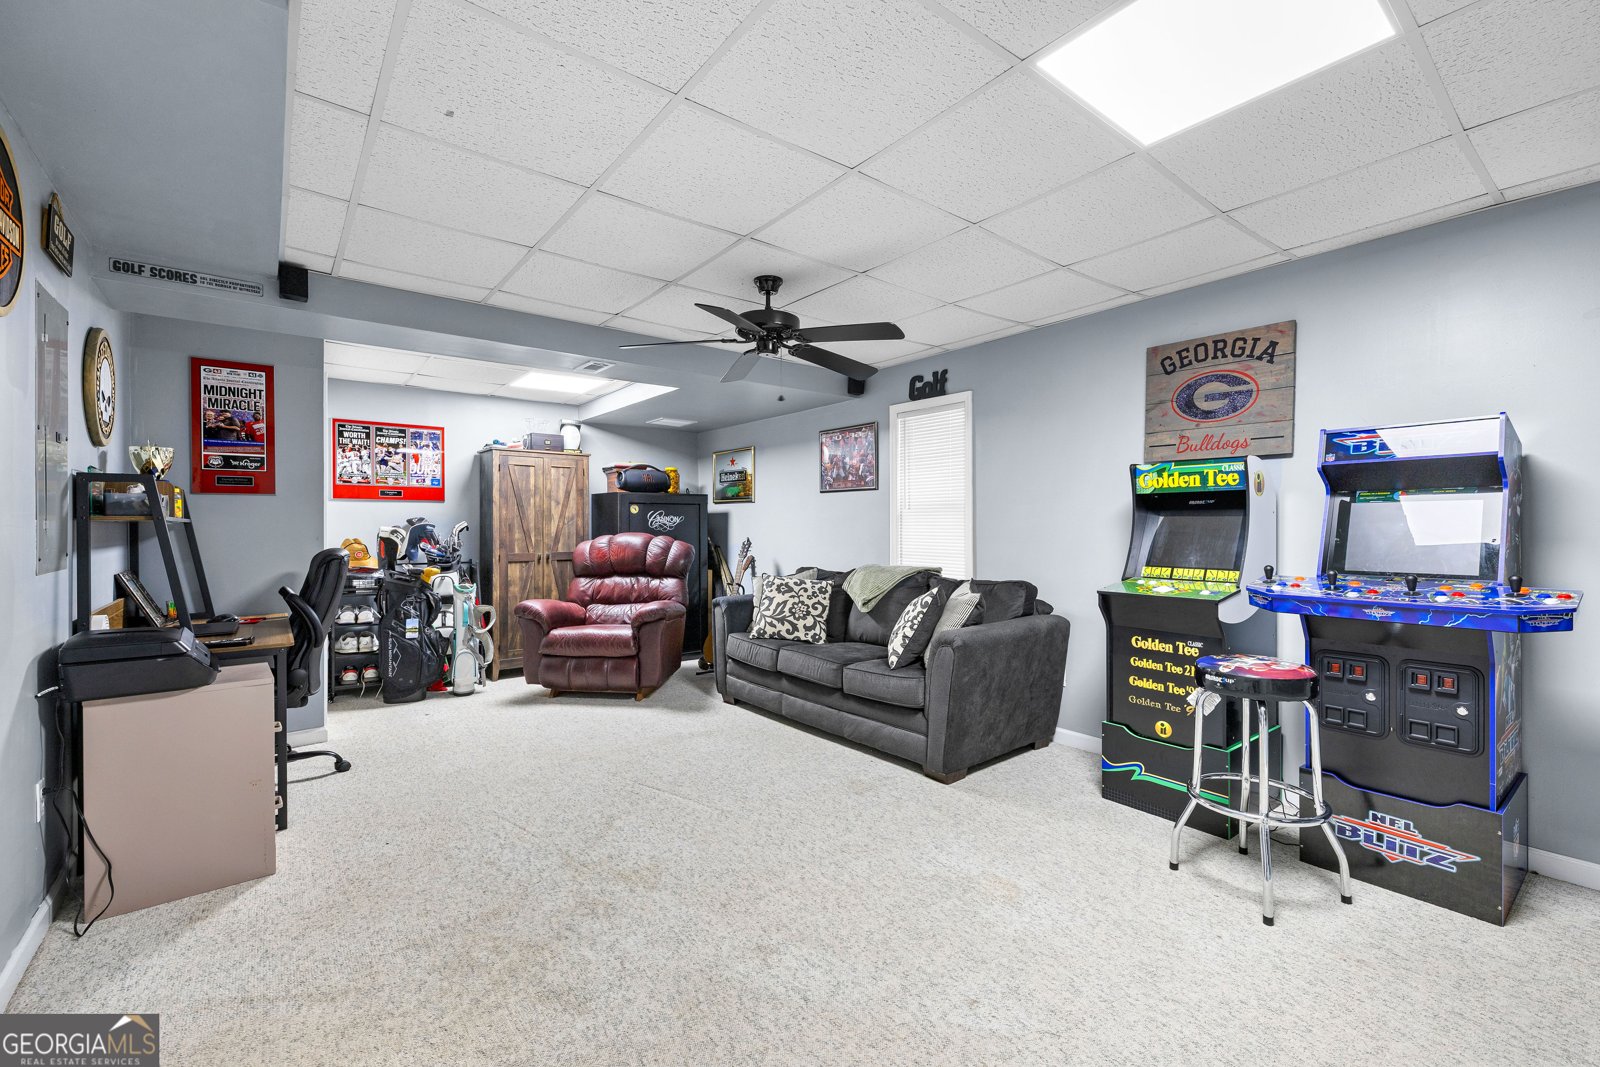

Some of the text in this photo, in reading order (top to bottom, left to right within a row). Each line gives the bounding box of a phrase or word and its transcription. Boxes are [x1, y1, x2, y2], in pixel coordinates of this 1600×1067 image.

[54, 215, 72, 250] GOLF
[112, 260, 198, 285] GOLF SCORES
[1159, 337, 1279, 376] GEORGIA
[203, 384, 264, 400] MIDNIGHT
[908, 368, 949, 401] Golf
[207, 397, 261, 412] MIRACLE
[343, 431, 366, 439] WORTH
[352, 438, 370, 446] WAIT!
[375, 436, 407, 445] CHAMPS!
[1175, 433, 1250, 455] Bulldogs
[240, 459, 261, 469] Kroger
[720, 471, 747, 483] Heineken
[1138, 469, 1240, 489] Golden Tee
[1131, 635, 1204, 657] Golden Tee CLASSIC
[1130, 656, 1164, 672] Golden
[1164, 661, 1184, 675] Tee
[1128, 675, 1165, 692] Golden
[1166, 681, 1186, 696] Tee
[1128, 695, 1162, 709] Golden
[1164, 702, 1181, 713] Tee
[1184, 704, 1196, 716] '9
[1369, 810, 1419, 834] NFL
